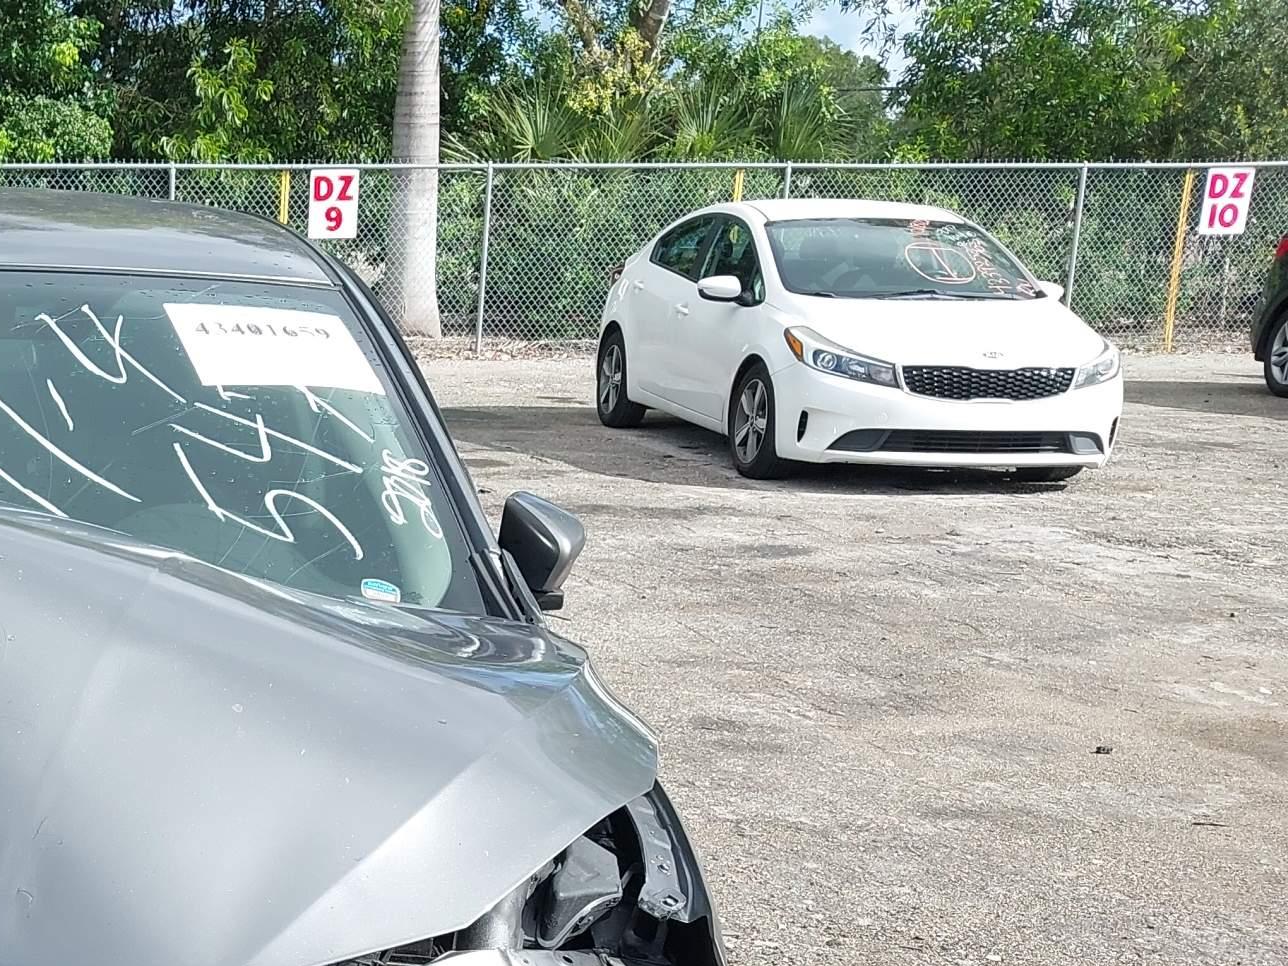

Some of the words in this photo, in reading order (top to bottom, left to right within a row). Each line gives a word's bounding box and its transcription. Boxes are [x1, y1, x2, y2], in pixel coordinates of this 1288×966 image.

[314, 175, 355, 201] DZ
[1208, 173, 1250, 199] DZ
[325, 206, 343, 231] 9
[1208, 203, 1239, 228] 10
